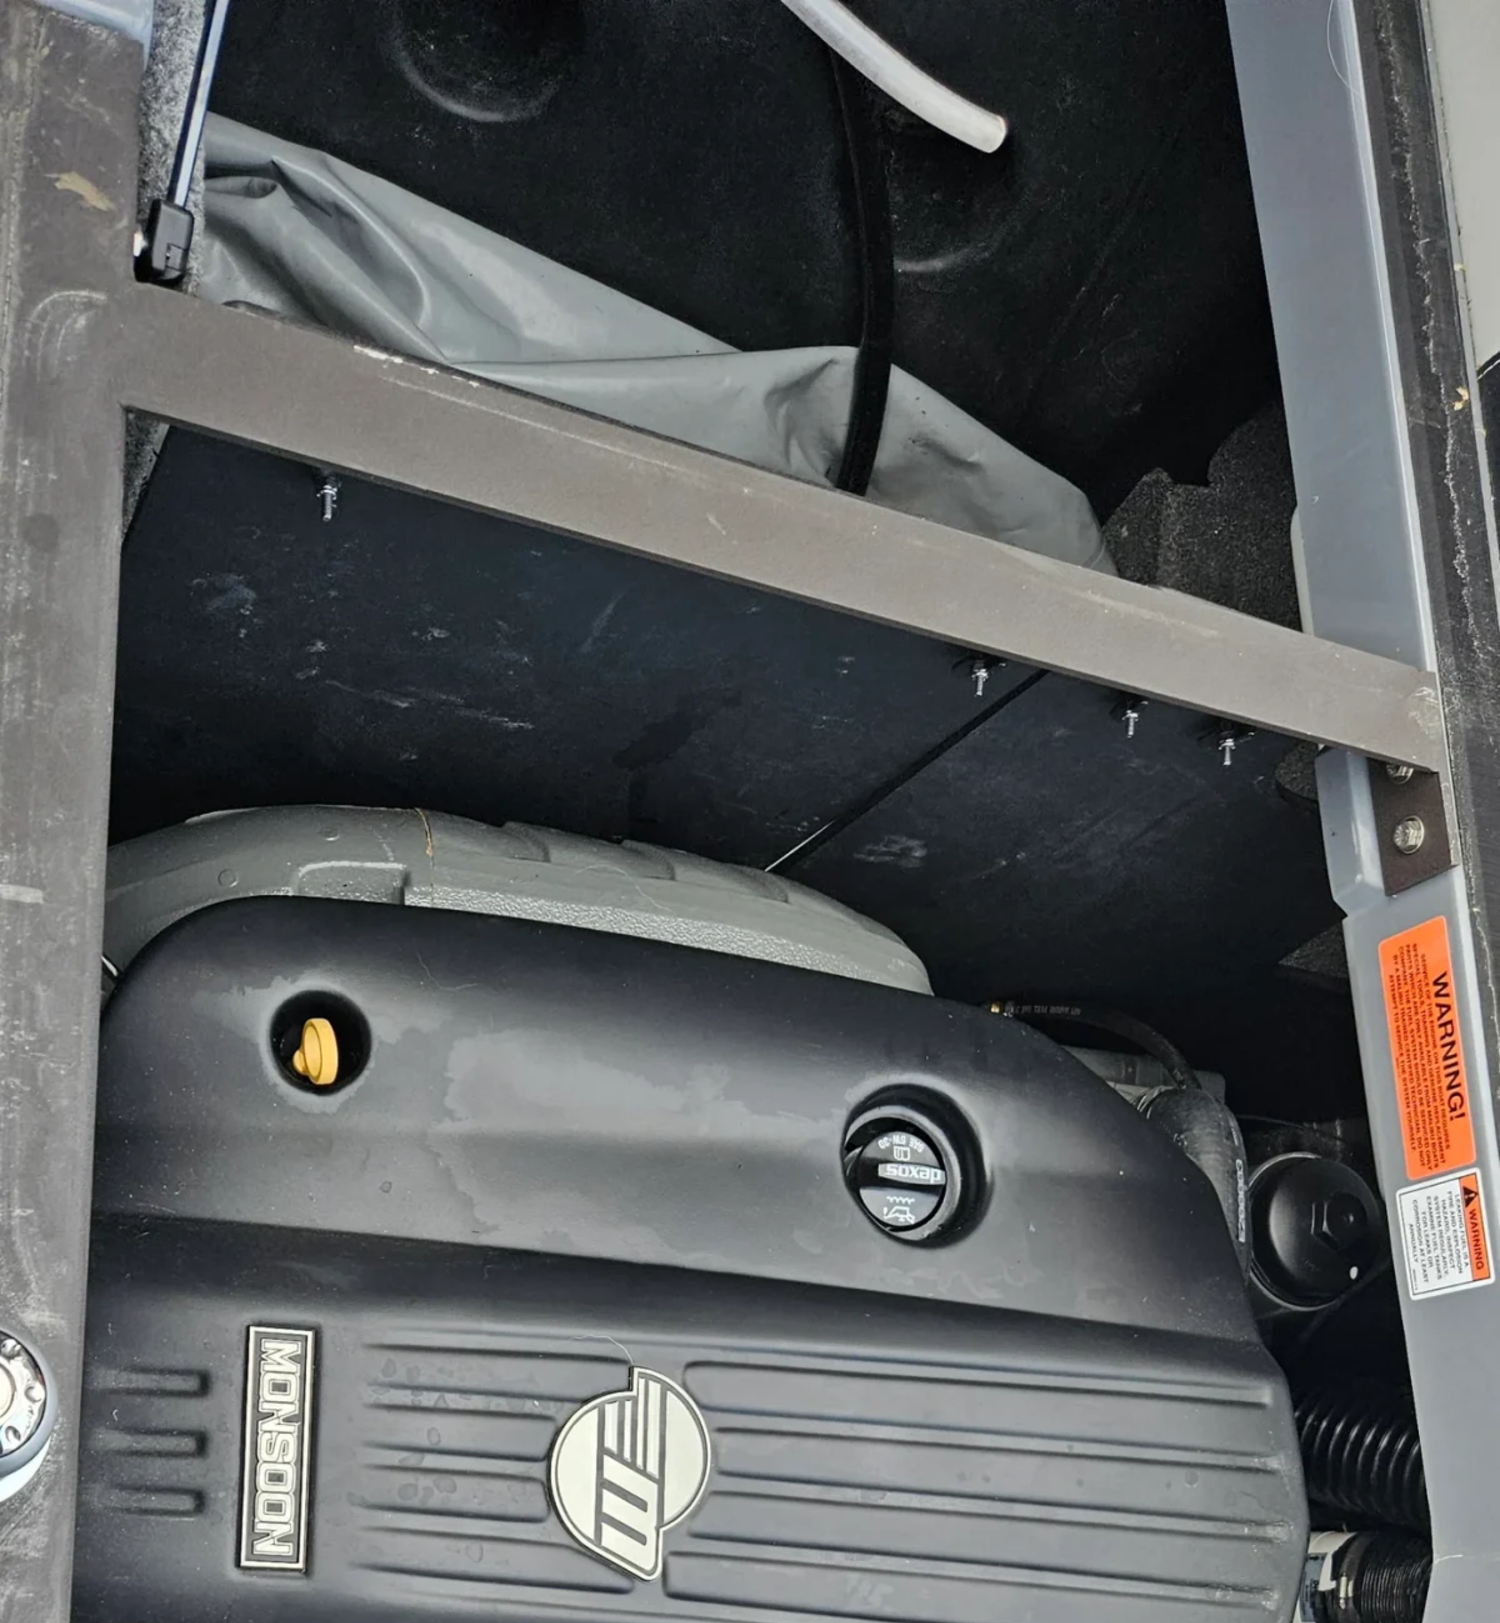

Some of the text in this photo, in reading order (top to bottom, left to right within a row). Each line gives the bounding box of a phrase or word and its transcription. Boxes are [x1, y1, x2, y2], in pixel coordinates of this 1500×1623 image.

[1405, 944, 1413, 970] PARTS
[1388, 974, 1397, 1009] ATTEMPT
[1408, 972, 1416, 999] WHICH
[1393, 1012, 1399, 1023] TO
[1392, 954, 1398, 965] BY
[1395, 974, 1403, 1005] MALIBU
[1399, 1006, 1408, 1041] TRAINED
[1404, 1043, 1413, 1083] CERTIFIED
[1416, 1136, 1423, 1149] DO
[1394, 1024, 1403, 1057] SERVICE
[1409, 1028, 1417, 1060] SYSTEM
[1412, 943, 1421, 975] SPECIAL
[1420, 1009, 1430, 1047] TRAINING
[1428, 1068, 1437, 1102] GENUINE
[1433, 1104, 1445, 1163] REPLACEMENT
[1420, 953, 1429, 986] SERVICE
[1425, 989, 1430, 1000] OF
[1429, 1019, 1437, 1049] ENGINE
[1433, 1051, 1438, 1064] ON
[1440, 1108, 1450, 1149] REQUIRES
[1431, 970, 1465, 1120] WARNING!
[1413, 1062, 1422, 1095] SHOULD
[1418, 1041, 1427, 1081] AVAILABLE
[1402, 1077, 1410, 1108] SYSTEM
[1418, 1096, 1424, 1105] BE
[1423, 1084, 1431, 1108] FROM
[1420, 1109, 1429, 1148] SERVICED
[1427, 1109, 1435, 1140] MALIBU
[877, 1135, 924, 1152] SAE 5W-30
[885, 1163, 940, 1184] dexos
[1426, 1195, 1435, 1230] EXAMINE
[1433, 1195, 1442, 1227] SYSTEM
[1454, 1194, 1463, 1228] LEAKING
[1462, 1252, 1467, 1260] IS
[1408, 1223, 1418, 1263] ANNUALLY
[1412, 1199, 1428, 1283] CORROSION AT LEAST
[1423, 1229, 1431, 1254] LEAKS
[1427, 1255, 1432, 1267] OR
[1445, 1235, 1455, 1269] INSPECT
[1452, 1228, 1462, 1273] EXPLOSION
[1468, 1209, 1484, 1270] WARNING
[253, 1338, 302, 1556] MONSOON
